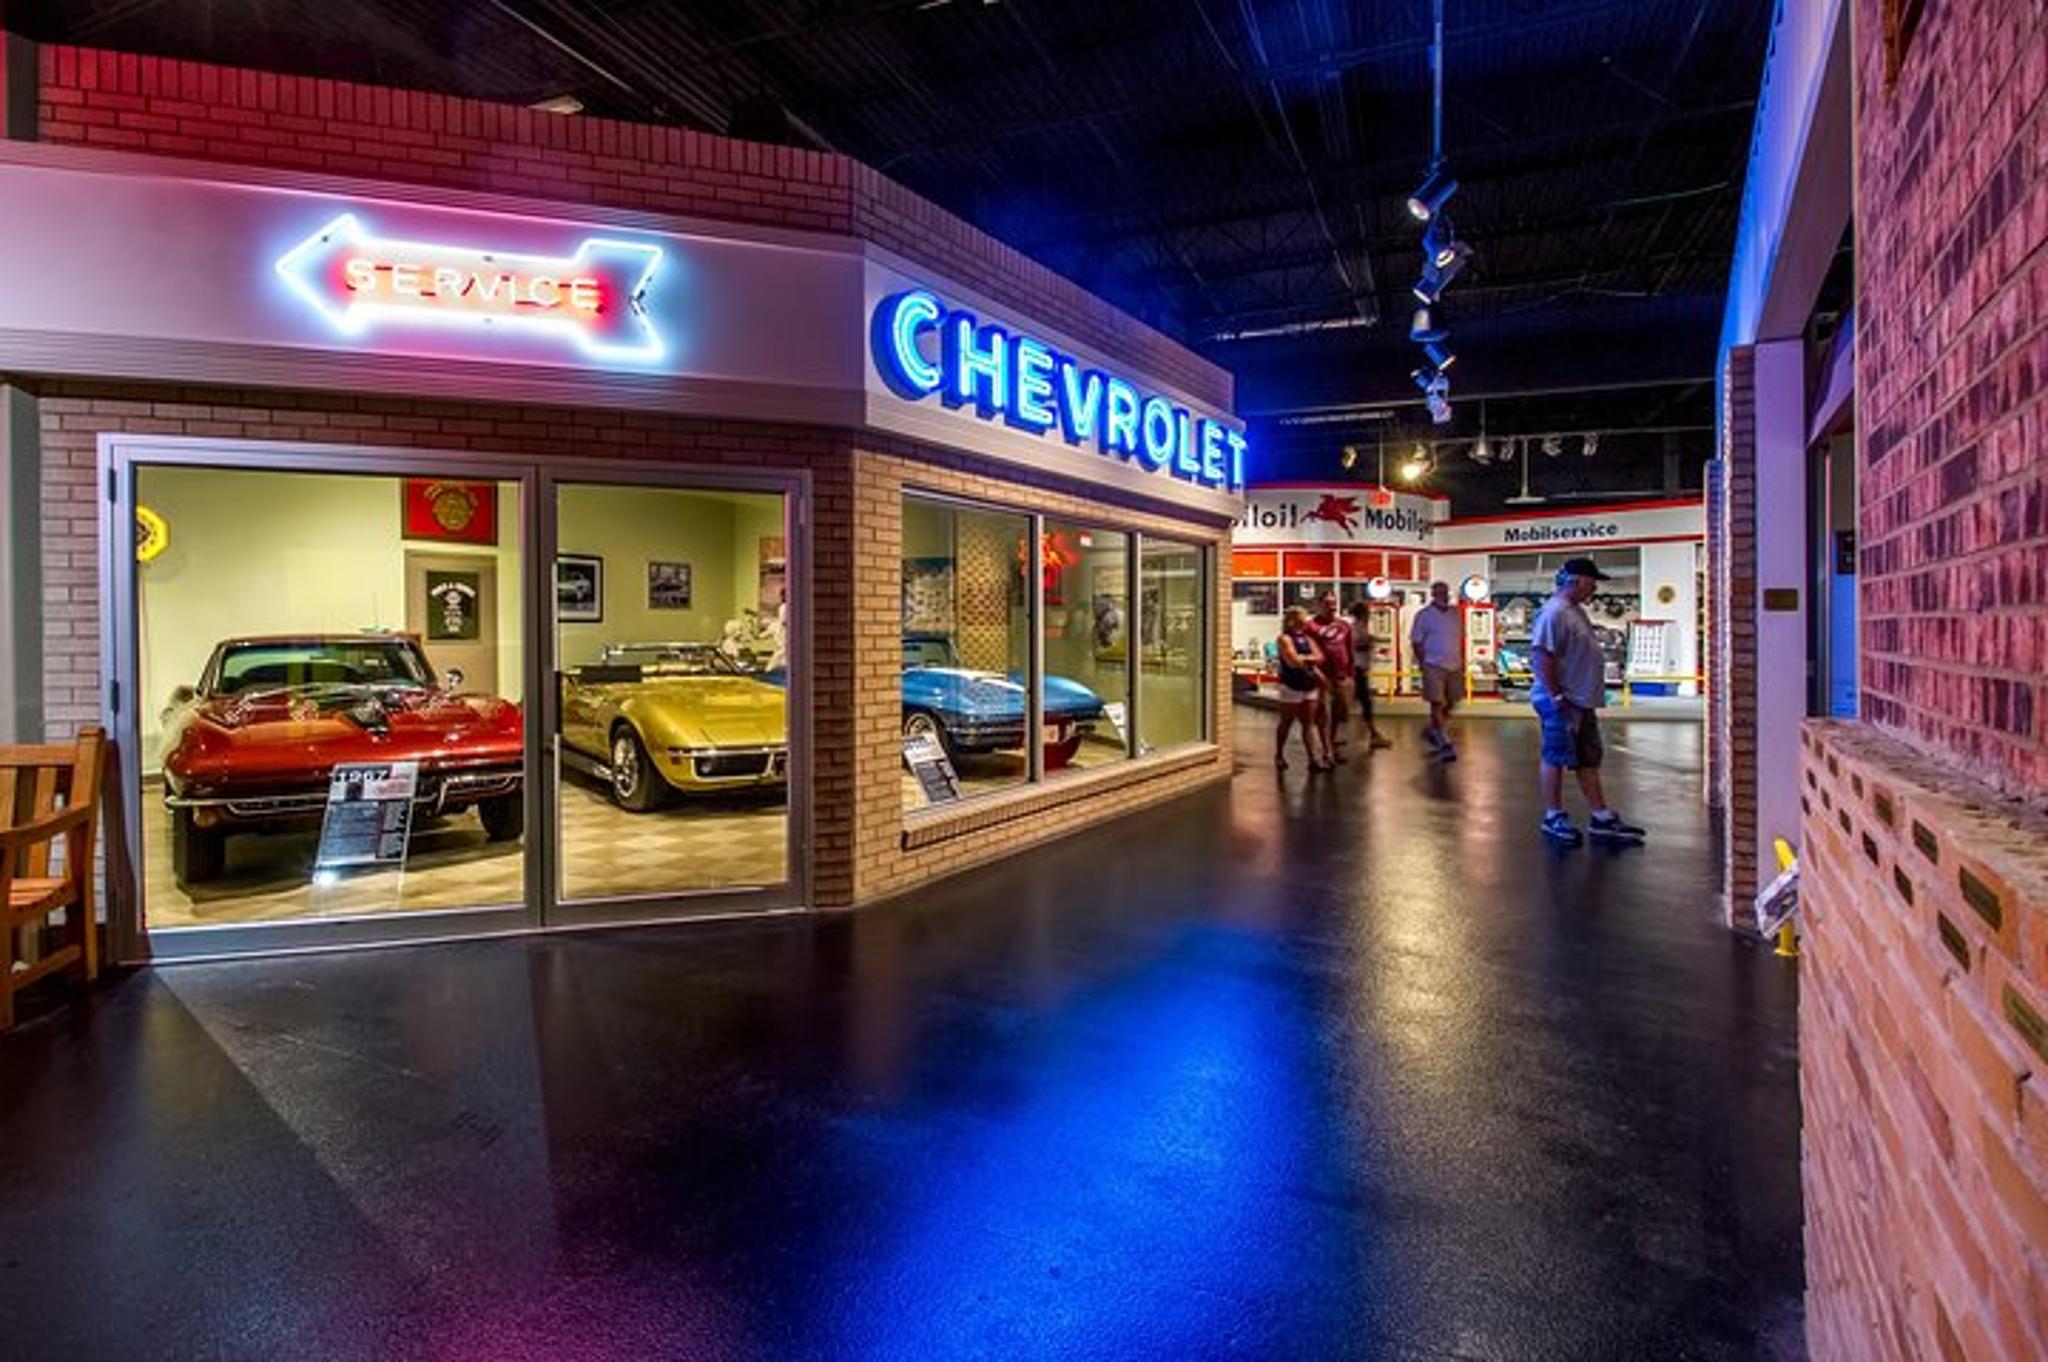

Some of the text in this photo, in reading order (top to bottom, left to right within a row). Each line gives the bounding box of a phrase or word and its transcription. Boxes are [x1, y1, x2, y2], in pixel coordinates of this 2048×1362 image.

[344, 258, 602, 310] SERVICE
[872, 289, 1249, 490] CHEVROLET
[1503, 522, 1619, 543] Mobilservice
